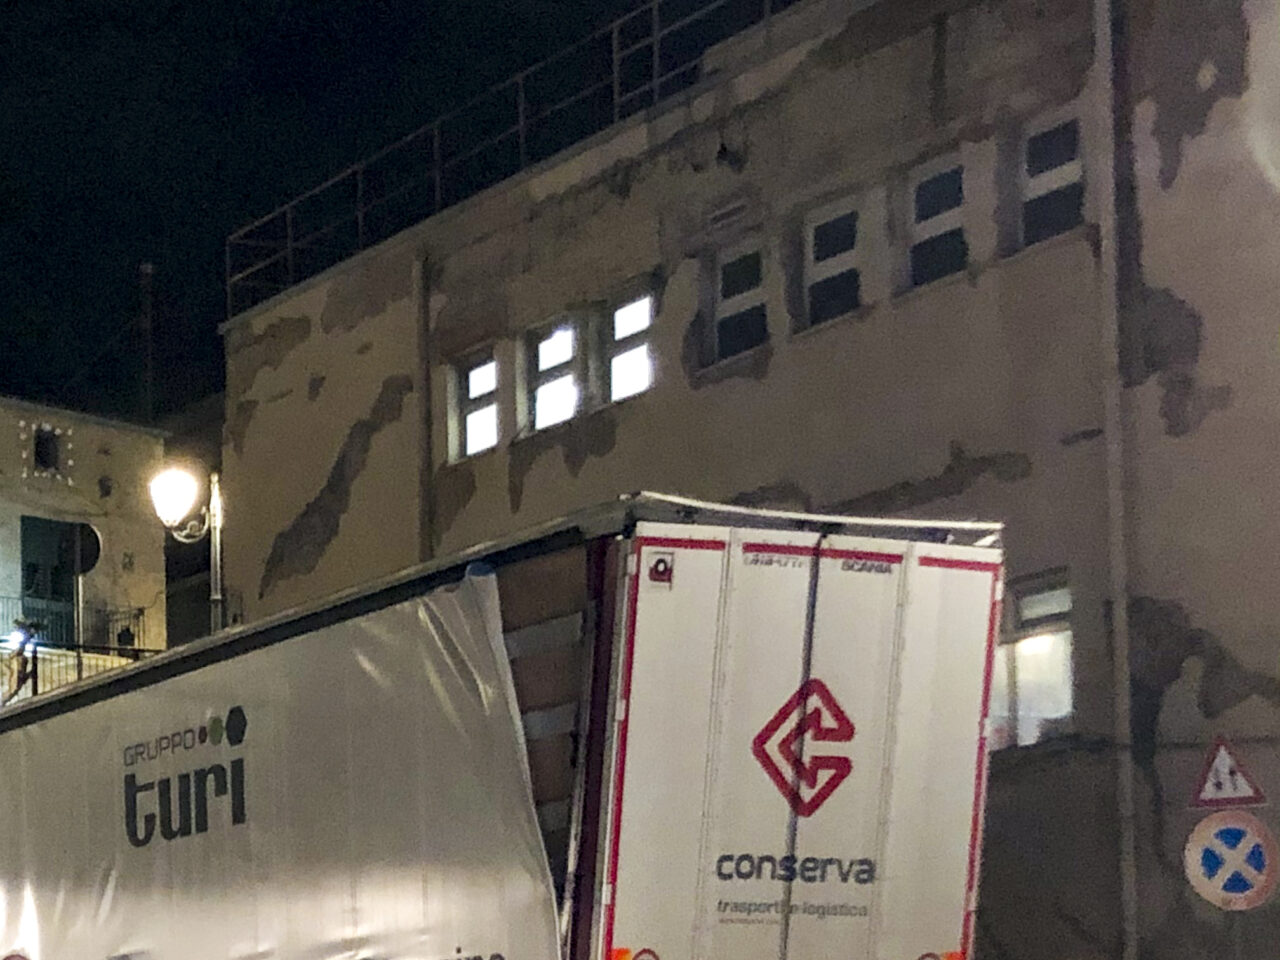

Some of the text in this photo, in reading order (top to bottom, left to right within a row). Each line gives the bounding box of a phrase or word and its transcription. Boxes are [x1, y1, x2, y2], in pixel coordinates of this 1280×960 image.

[123, 728, 196, 767] GRUPPO
[123, 756, 247, 848] turi
[716, 853, 877, 885] conserva
